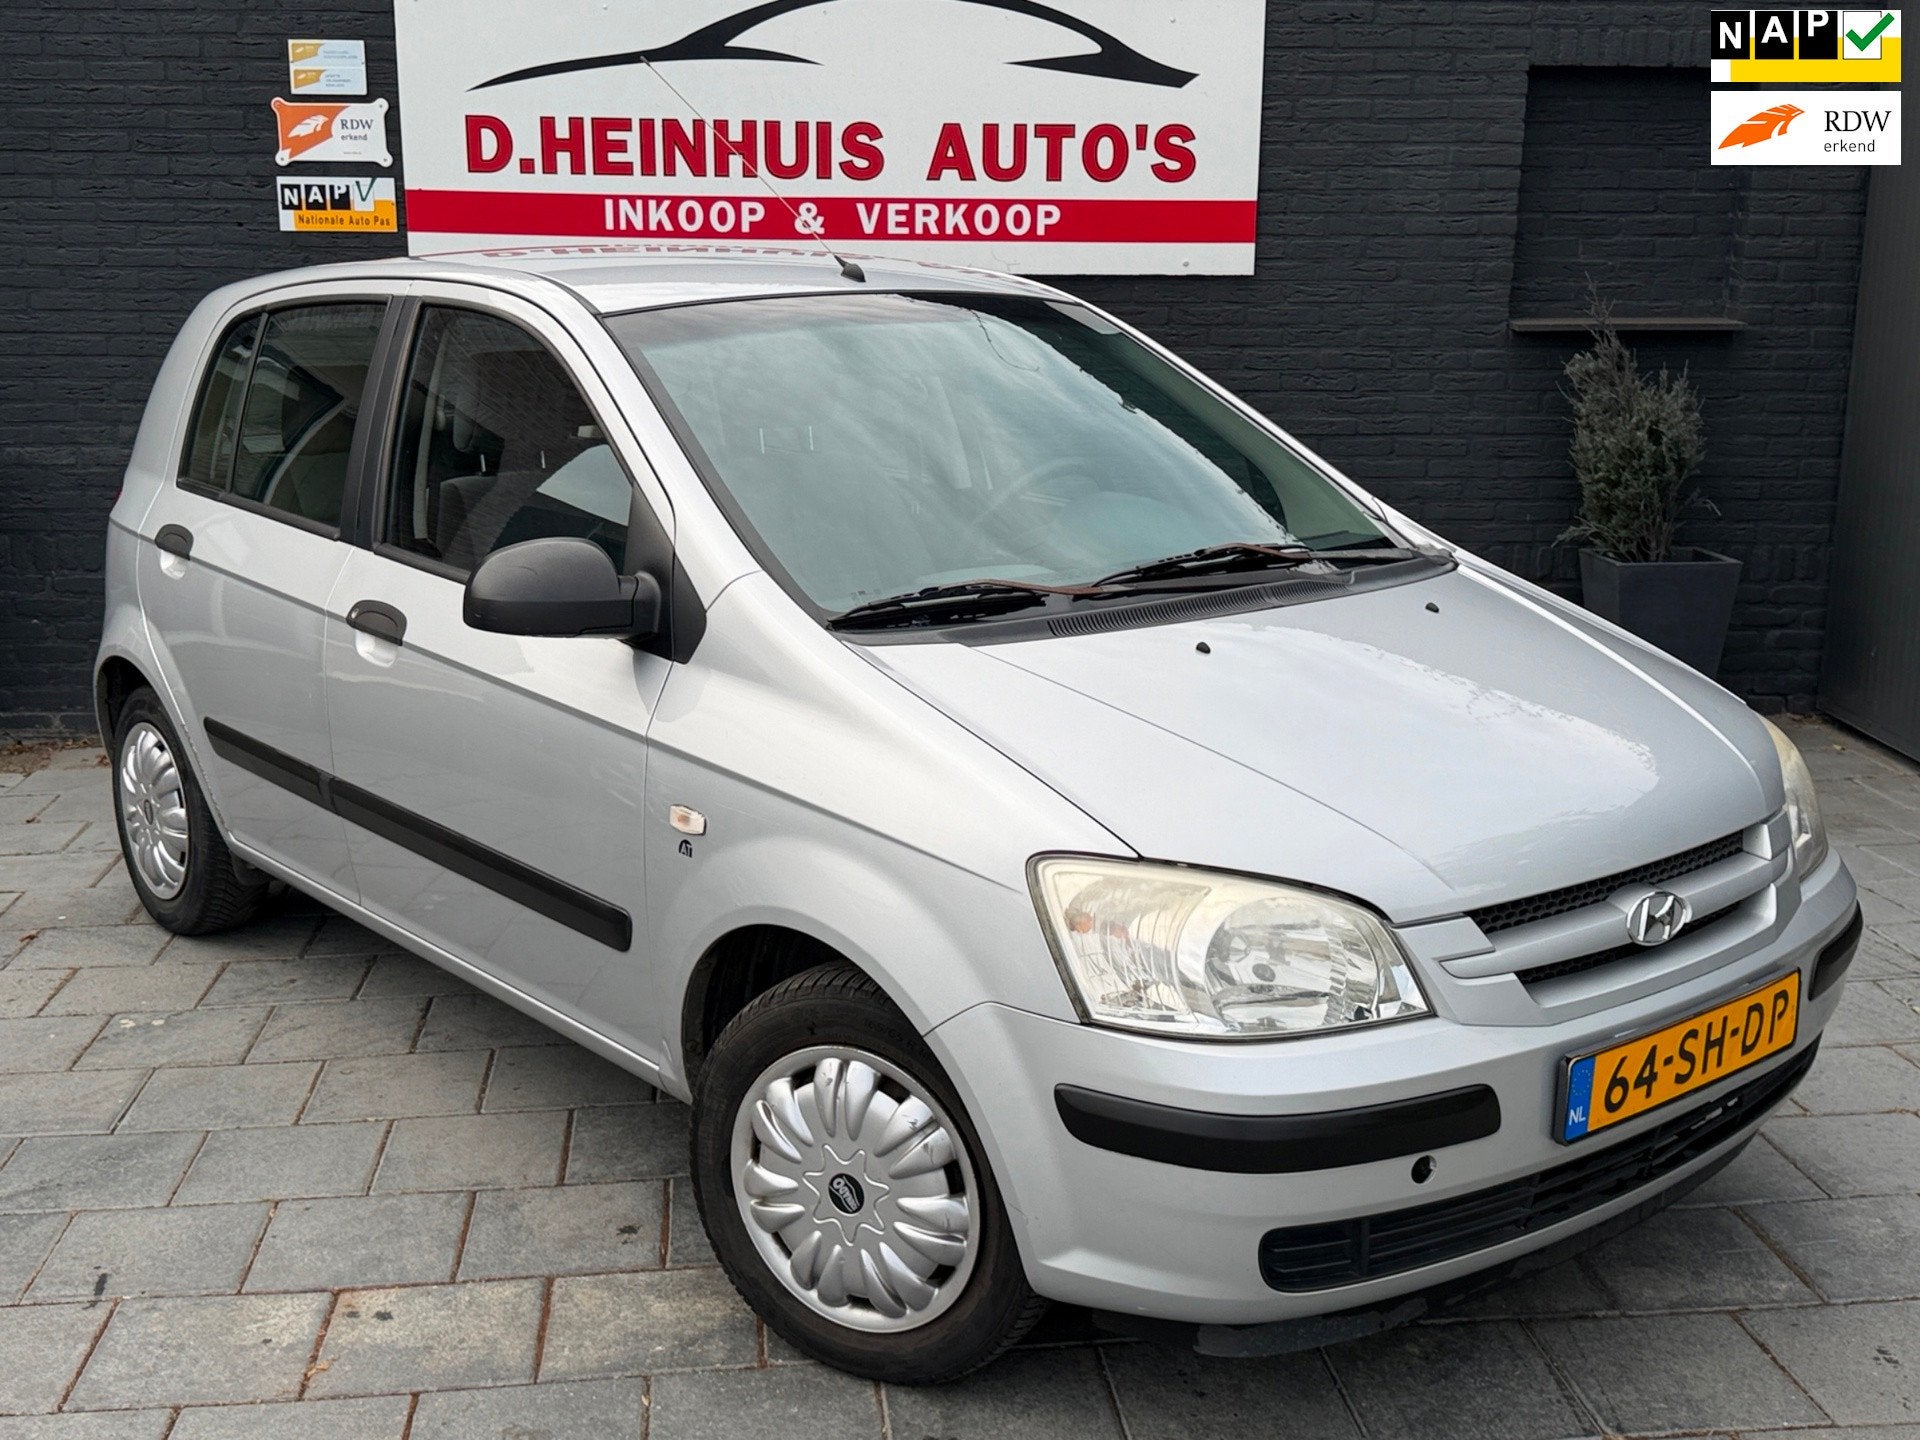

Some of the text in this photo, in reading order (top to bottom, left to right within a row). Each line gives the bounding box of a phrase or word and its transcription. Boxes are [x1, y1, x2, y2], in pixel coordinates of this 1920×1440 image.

[340, 118, 374, 130] RDW
[340, 133, 368, 141] erkend
[464, 114, 1197, 183] D.HEINHUIS AUTO'S
[282, 184, 348, 206] NAP
[297, 214, 391, 227] Nationale Auto Pas
[604, 198, 1062, 237] INKOOP & VERKOOP
[1603, 988, 1790, 1114] 64-SH-DP
[1568, 1107, 1587, 1126] NL
